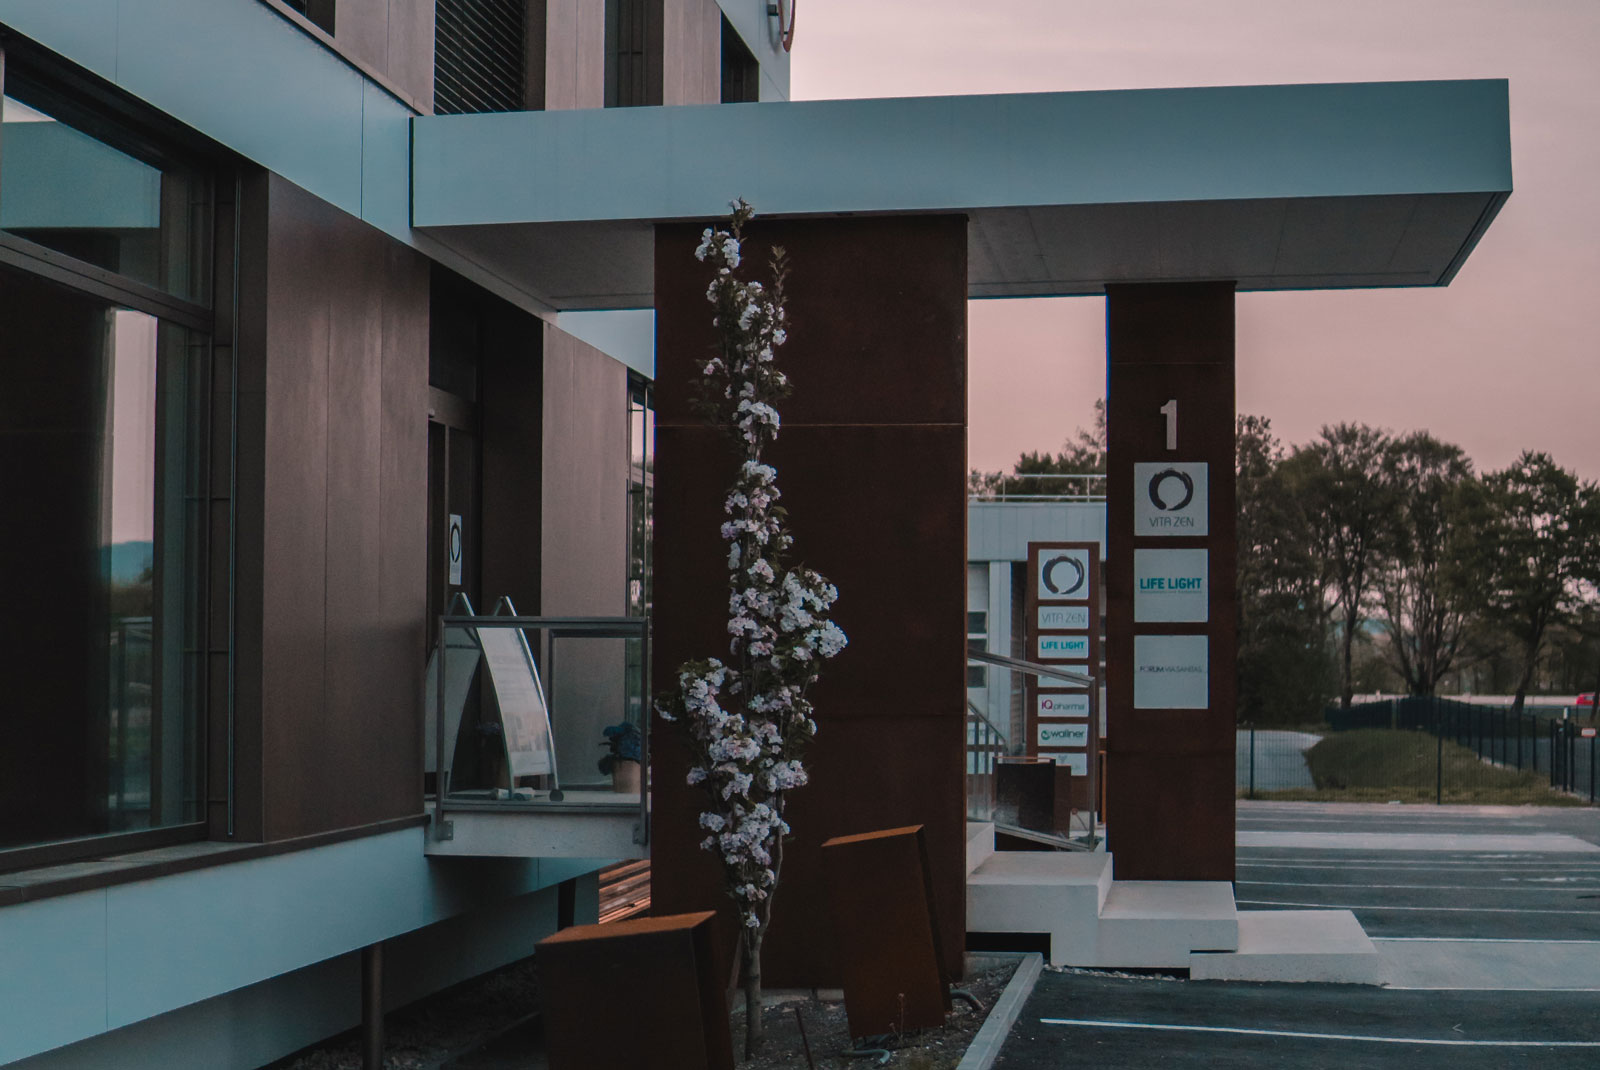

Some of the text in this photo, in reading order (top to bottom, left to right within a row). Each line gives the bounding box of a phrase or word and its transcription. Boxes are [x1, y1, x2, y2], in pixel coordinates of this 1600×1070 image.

[1160, 399, 1177, 450] 1
[1148, 516, 1194, 527] VITA ZEN
[1140, 577, 1202, 590] LIFE LIGHT
[1041, 612, 1085, 624] VITA ZEN
[1041, 640, 1084, 650] LIFE LIGHT
[1051, 729, 1085, 738] wallner
